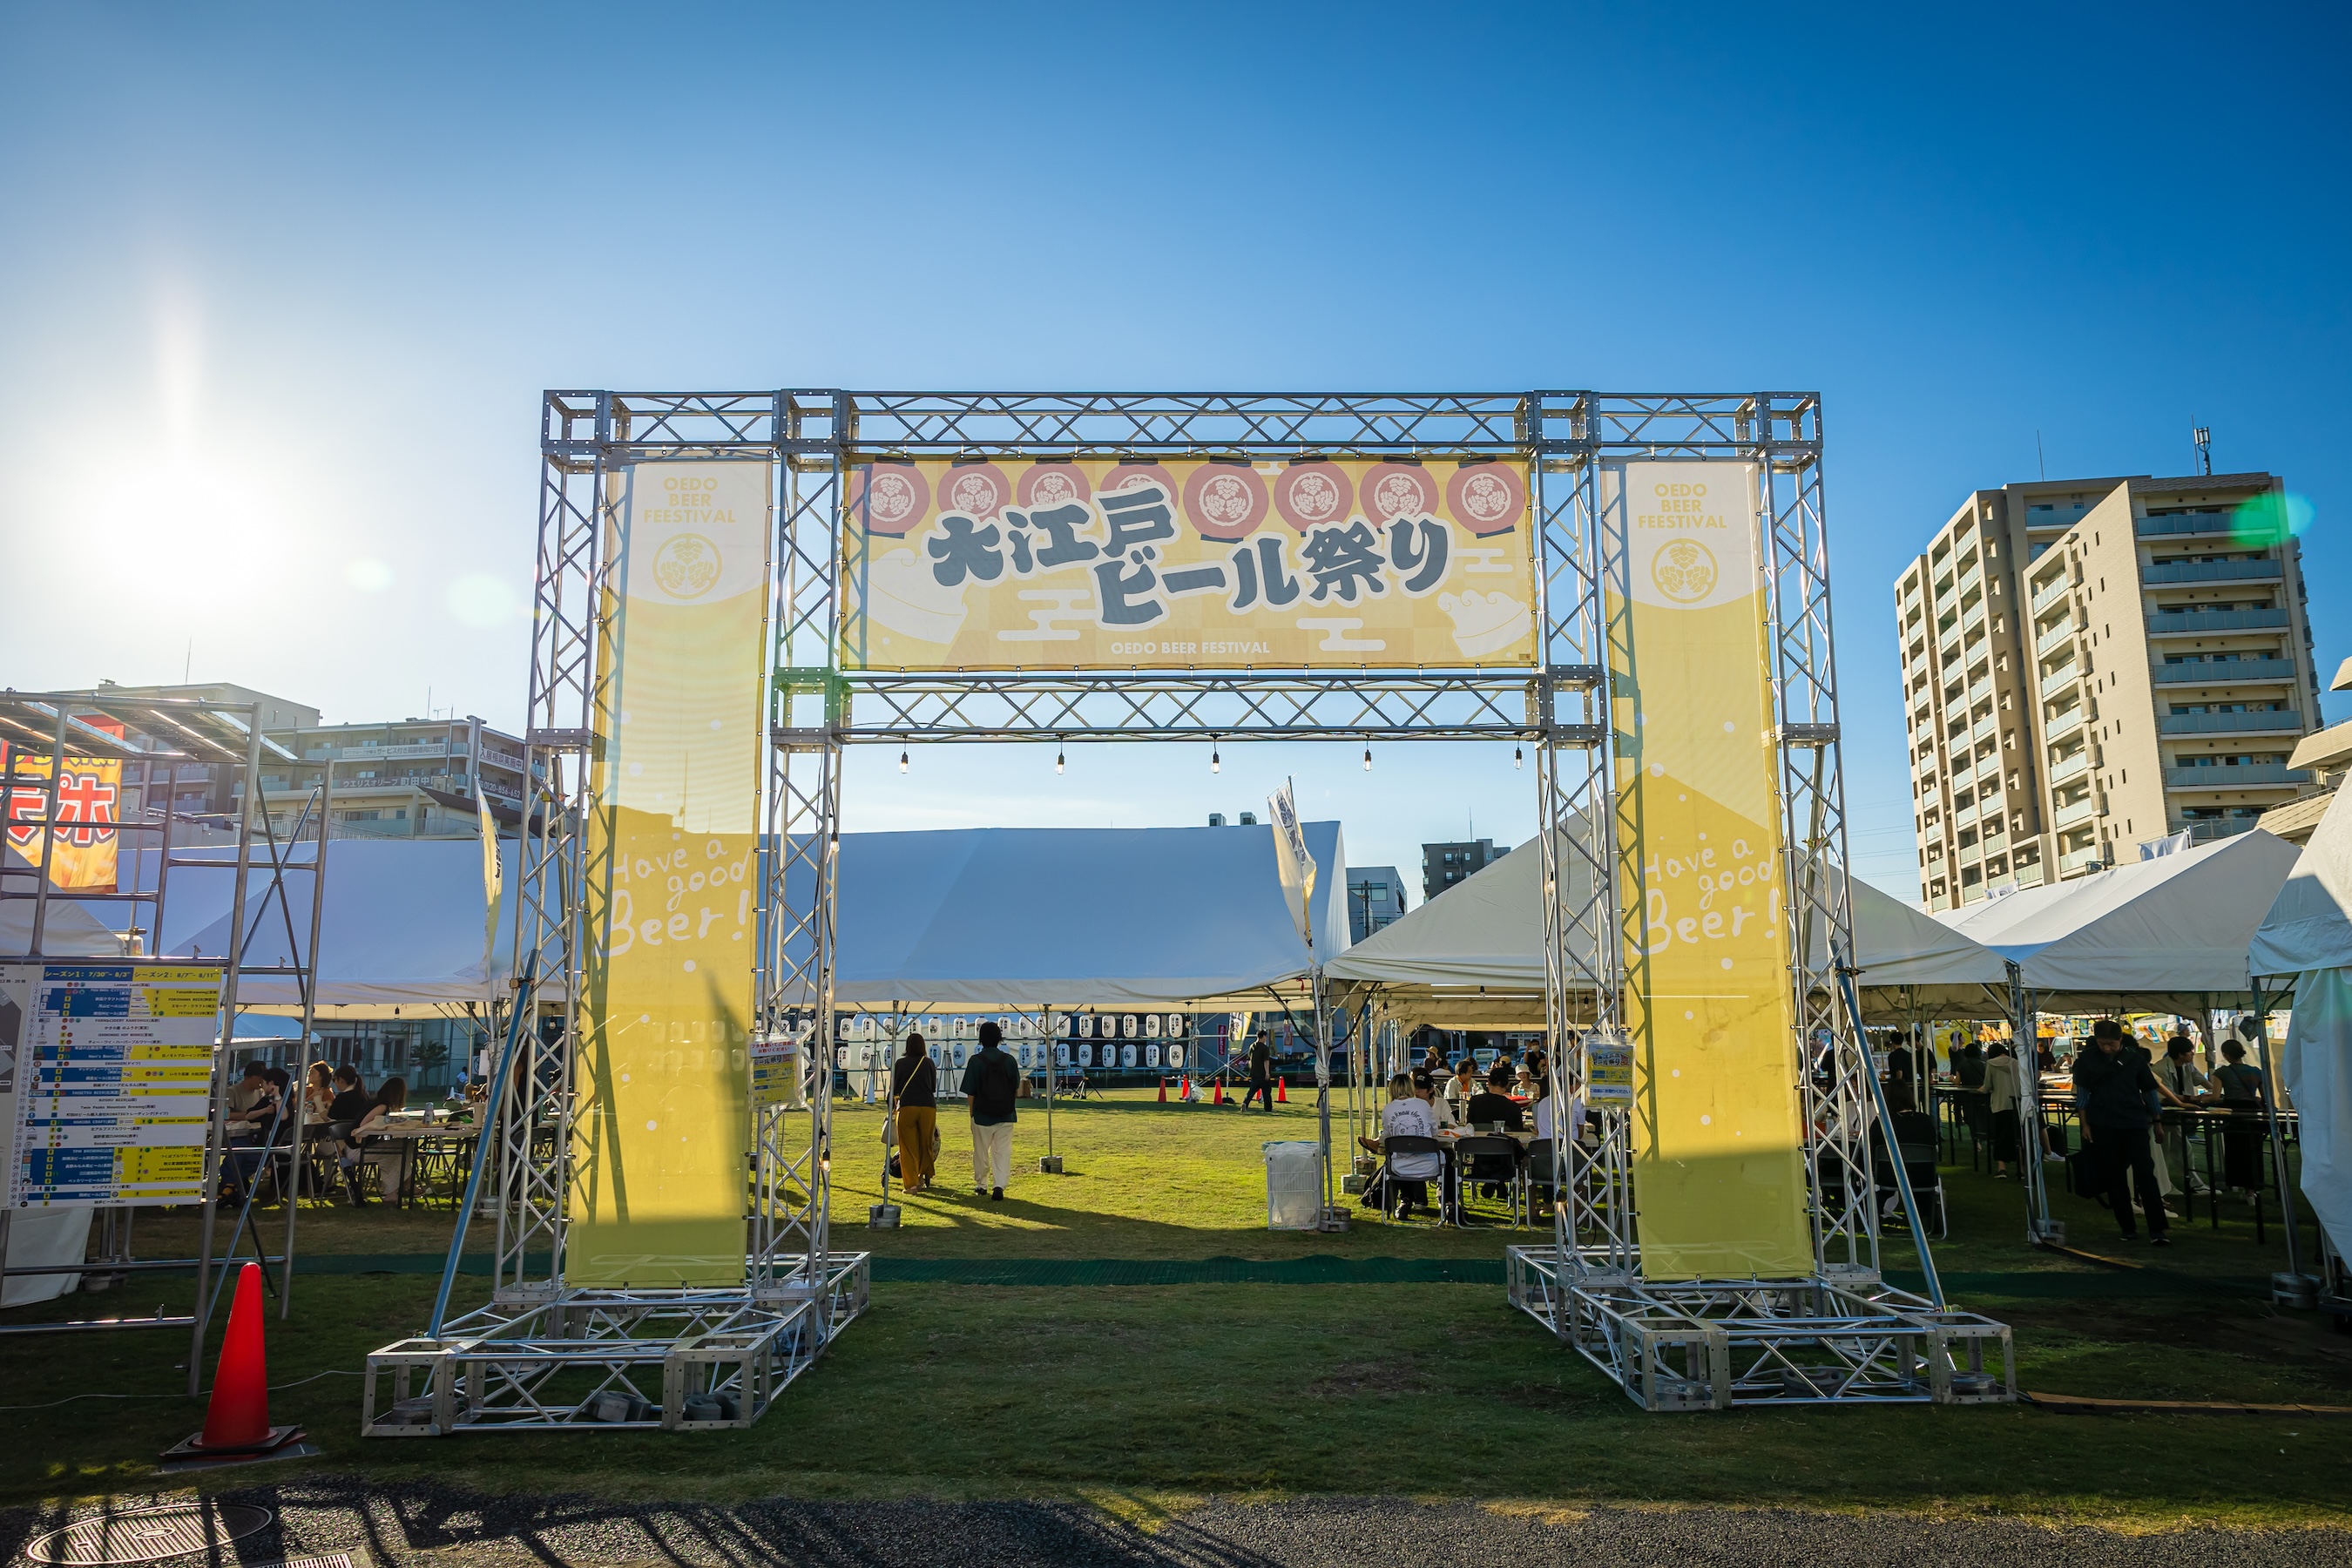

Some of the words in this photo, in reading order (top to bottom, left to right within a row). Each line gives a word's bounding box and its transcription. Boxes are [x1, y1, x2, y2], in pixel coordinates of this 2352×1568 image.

[663, 477, 718, 491] OEDO
[1654, 483, 1707, 497] OEDO
[669, 494, 711, 507] BEER
[1661, 499, 1702, 512] BEER
[643, 510, 736, 524] FEESTIVAL
[1638, 515, 1727, 529] FEESTIVAL
[929, 490, 1174, 586] 大江戸
[1093, 517, 1451, 625] ビール祭り
[1111, 642, 1156, 655] OEDO
[1160, 642, 1197, 655] BEER
[1201, 642, 1270, 655] FESTIVAL
[401, 775, 435, 787] 町田中
[607, 847, 689, 889] Have
[706, 839, 728, 860] a
[1639, 848, 1717, 889] Have
[1732, 839, 1754, 859] a
[666, 846, 751, 912] good
[1698, 846, 1775, 911] good
